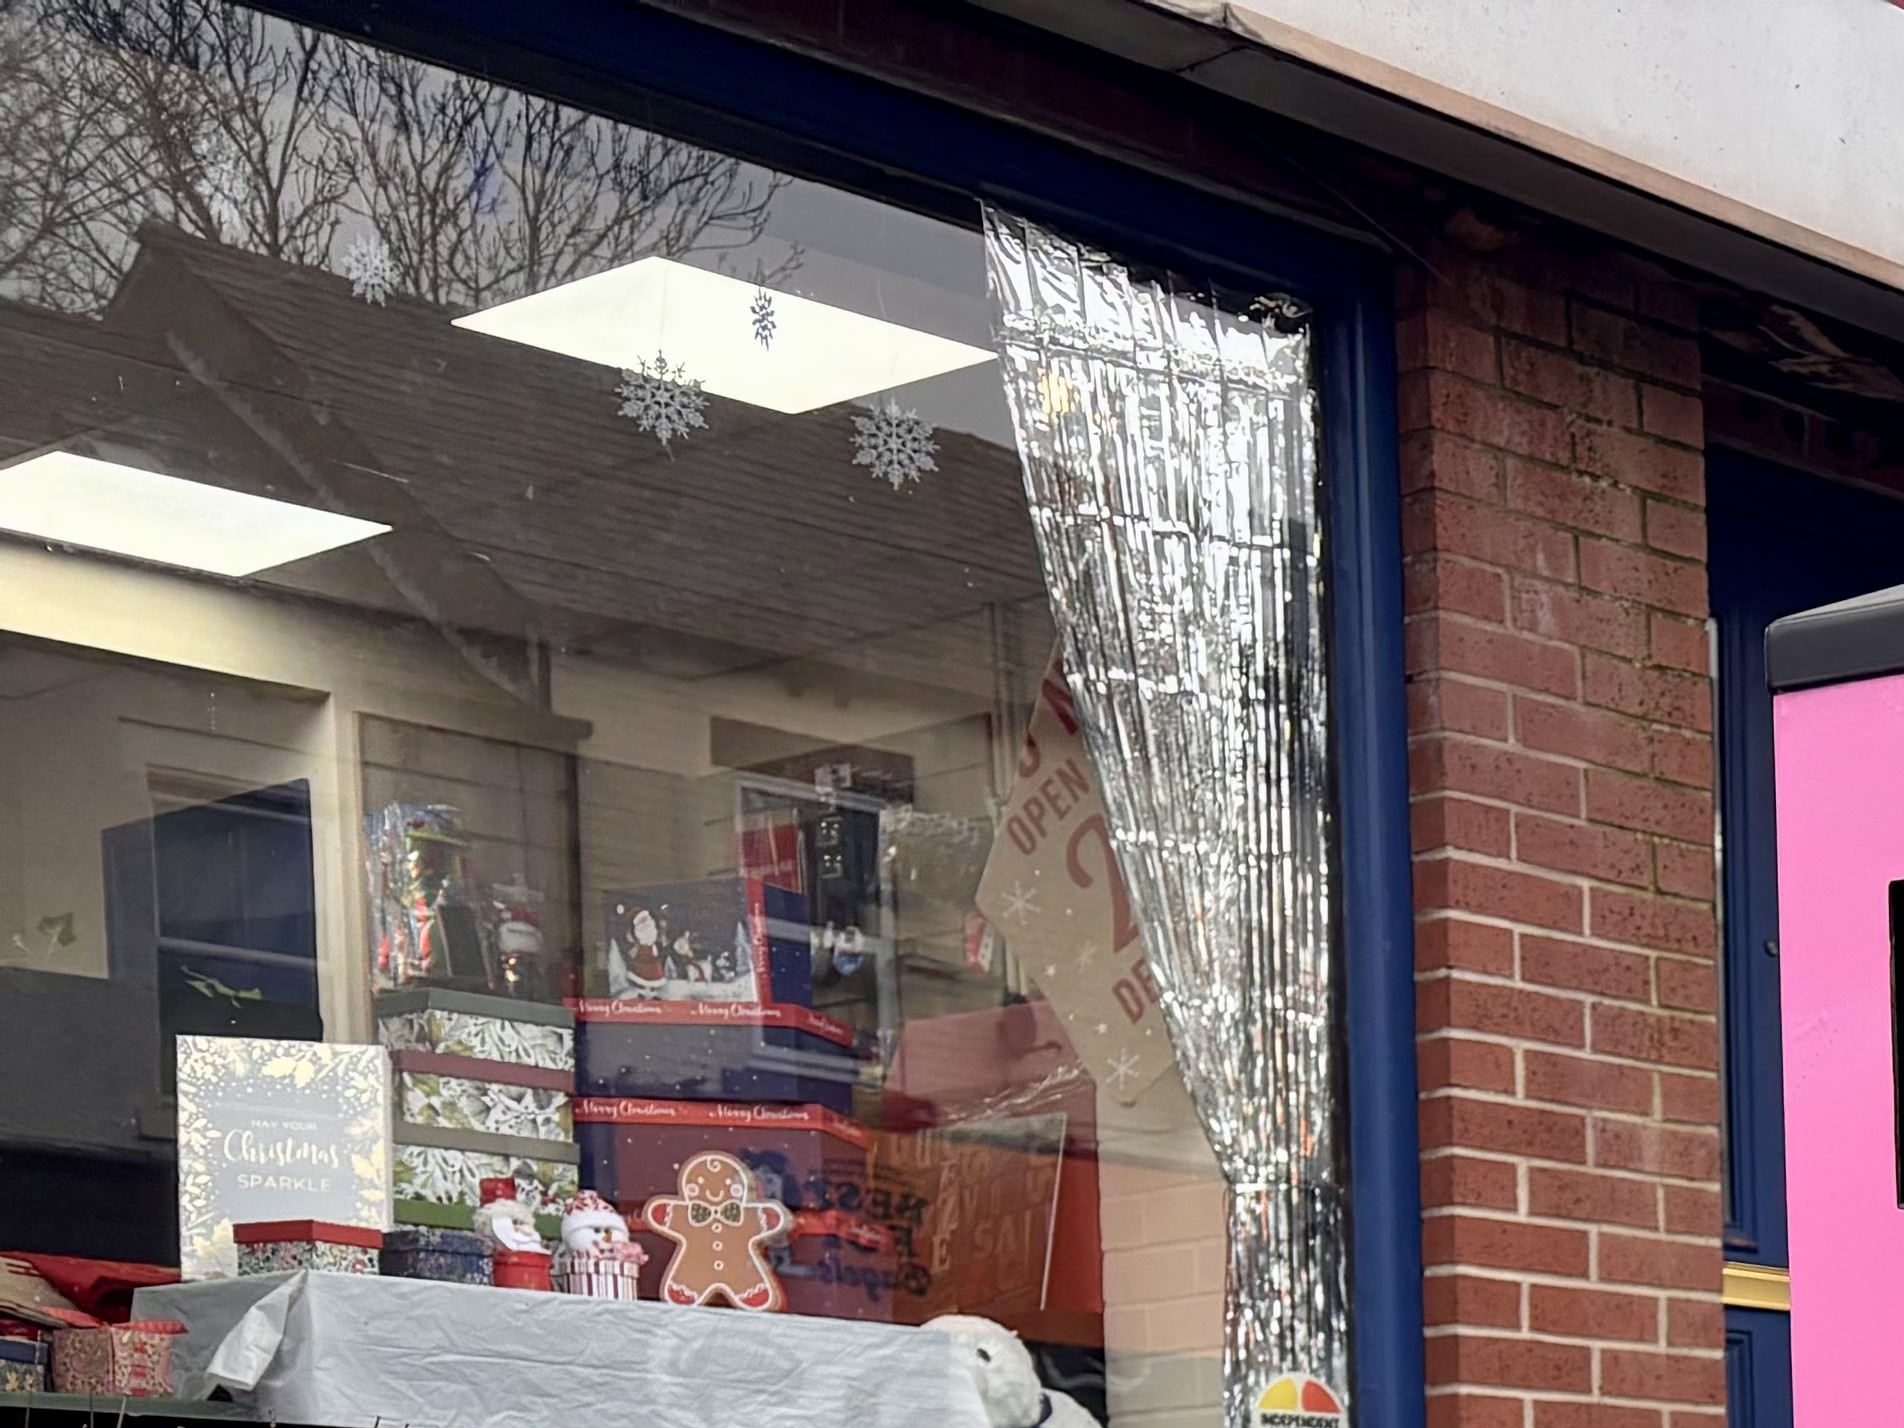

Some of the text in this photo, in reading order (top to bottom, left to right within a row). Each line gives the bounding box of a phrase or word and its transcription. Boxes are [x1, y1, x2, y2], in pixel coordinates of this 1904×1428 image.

[1007, 759, 1091, 857] OPEN
[282, 1121, 317, 1131] YOUR
[223, 1128, 339, 1169] Christmas
[237, 1173, 333, 1193] SPARKLE
